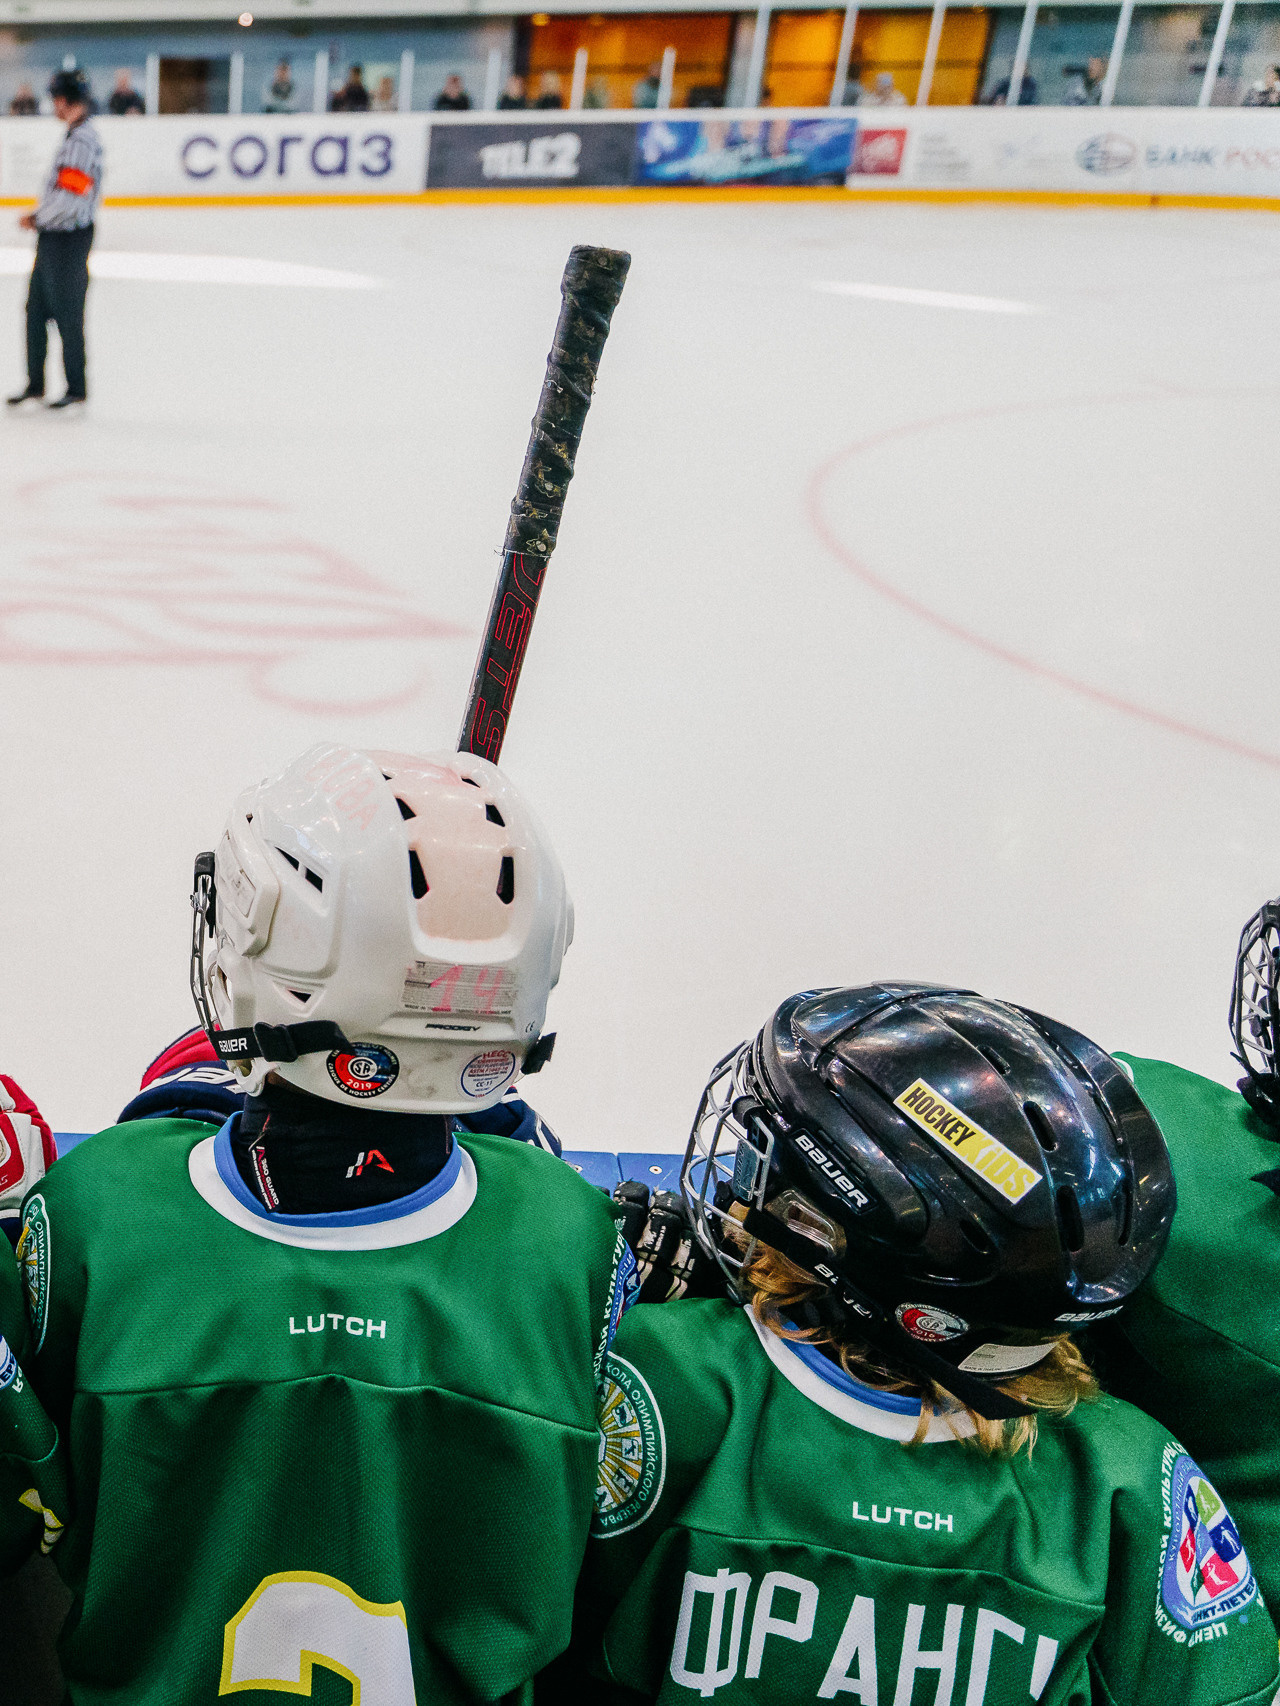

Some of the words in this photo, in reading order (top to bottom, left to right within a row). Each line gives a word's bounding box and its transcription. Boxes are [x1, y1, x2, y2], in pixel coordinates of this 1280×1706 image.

[181, 133, 394, 179] согаз
[430, 965, 505, 1015] 14
[346, 1078, 372, 1090] 2019
[902, 1086, 977, 1148] HOCKEY
[795, 1134, 869, 1209] BAUER
[288, 1312, 388, 1340] LUTCH
[852, 1501, 954, 1533] LUTCH
